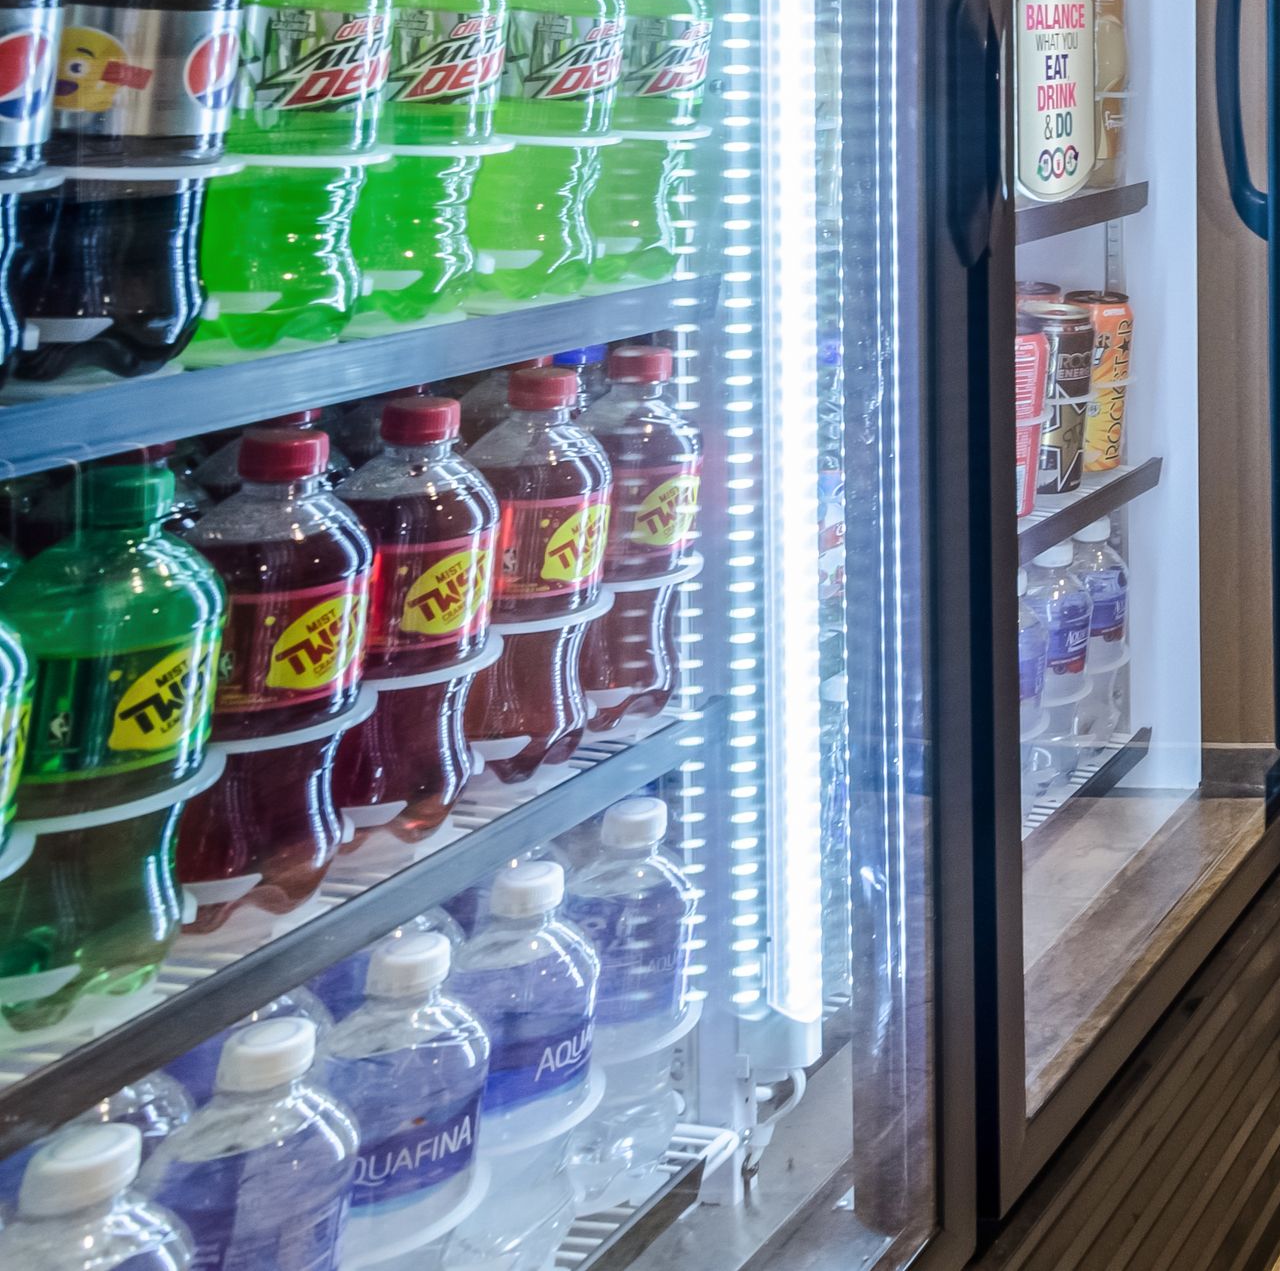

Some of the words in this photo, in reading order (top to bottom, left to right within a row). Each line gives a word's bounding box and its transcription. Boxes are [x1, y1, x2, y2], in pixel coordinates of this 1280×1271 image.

[1026, 4, 1085, 30] BALANCE
[1035, 33, 1060, 51] WHAT
[1062, 32, 1078, 49] YOU
[1037, 82, 1077, 111] DRINK
[1044, 114, 1053, 140] &
[1056, 111, 1072, 138] DO
[1059, 368, 1091, 380] ENERG
[436, 561, 463, 583] MIST
[306, 608, 337, 633] MIST
[534, 1021, 595, 1082] AQUA
[352, 1114, 473, 1187] QUAFINA
